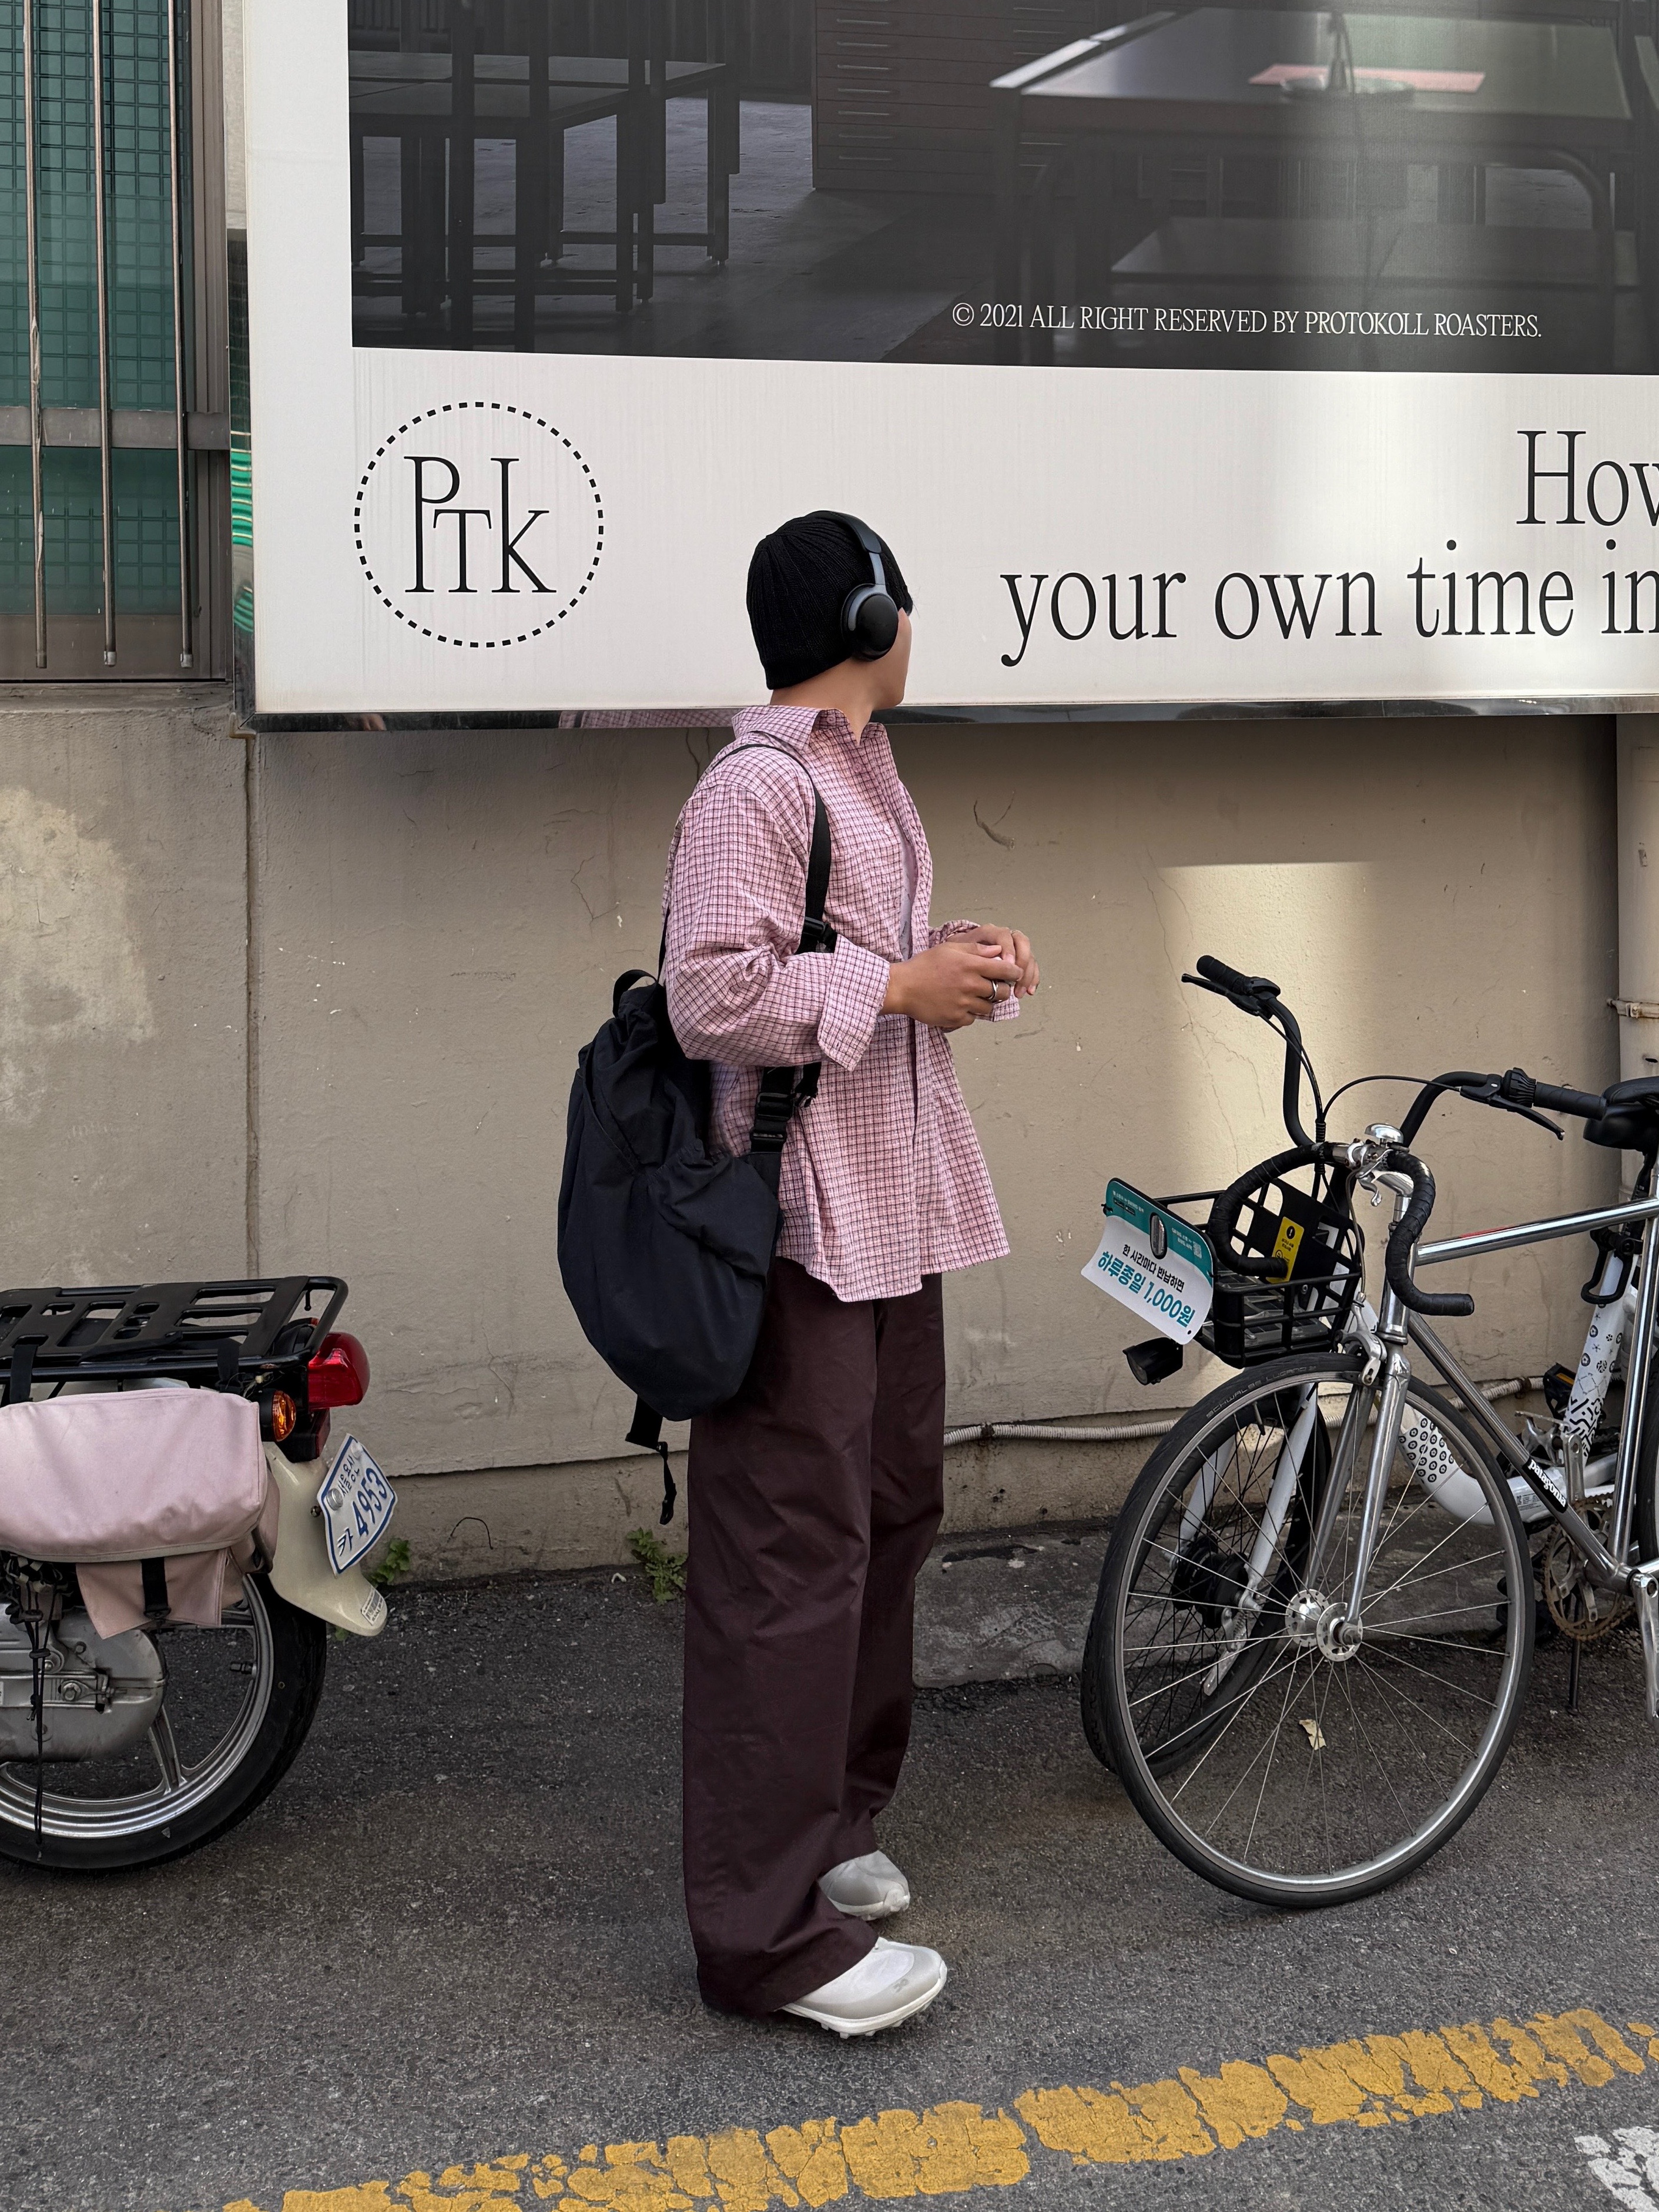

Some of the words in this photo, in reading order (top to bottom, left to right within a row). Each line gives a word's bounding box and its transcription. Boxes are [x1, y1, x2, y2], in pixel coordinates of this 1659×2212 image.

[980, 303, 1023, 327] 2021
[1029, 304, 1075, 329] ALL
[1080, 306, 1148, 330] RIGHT
[1154, 308, 1267, 333] RESERVED
[1272, 311, 1300, 333] BY
[1304, 311, 1429, 335] PROTOKOLL
[1433, 313, 1542, 337] ROASTERS.
[1000, 572, 1187, 667] your
[1215, 572, 1382, 640] own
[1407, 539, 1574, 638] time
[1601, 539, 1659, 634] in
[1098, 1251, 1147, 1294] 하루종일
[1143, 1281, 1196, 1328] 1,000원
[1122, 1244, 1131, 1256] 한
[1130, 1251, 1158, 1275] 시간마다
[1157, 1266, 1185, 1293] 반납하면
[1206, 1380, 1262, 1419] SCHWALBE
[353, 1467, 388, 1538] 4953
[1528, 1459, 1566, 1507] patagonia
